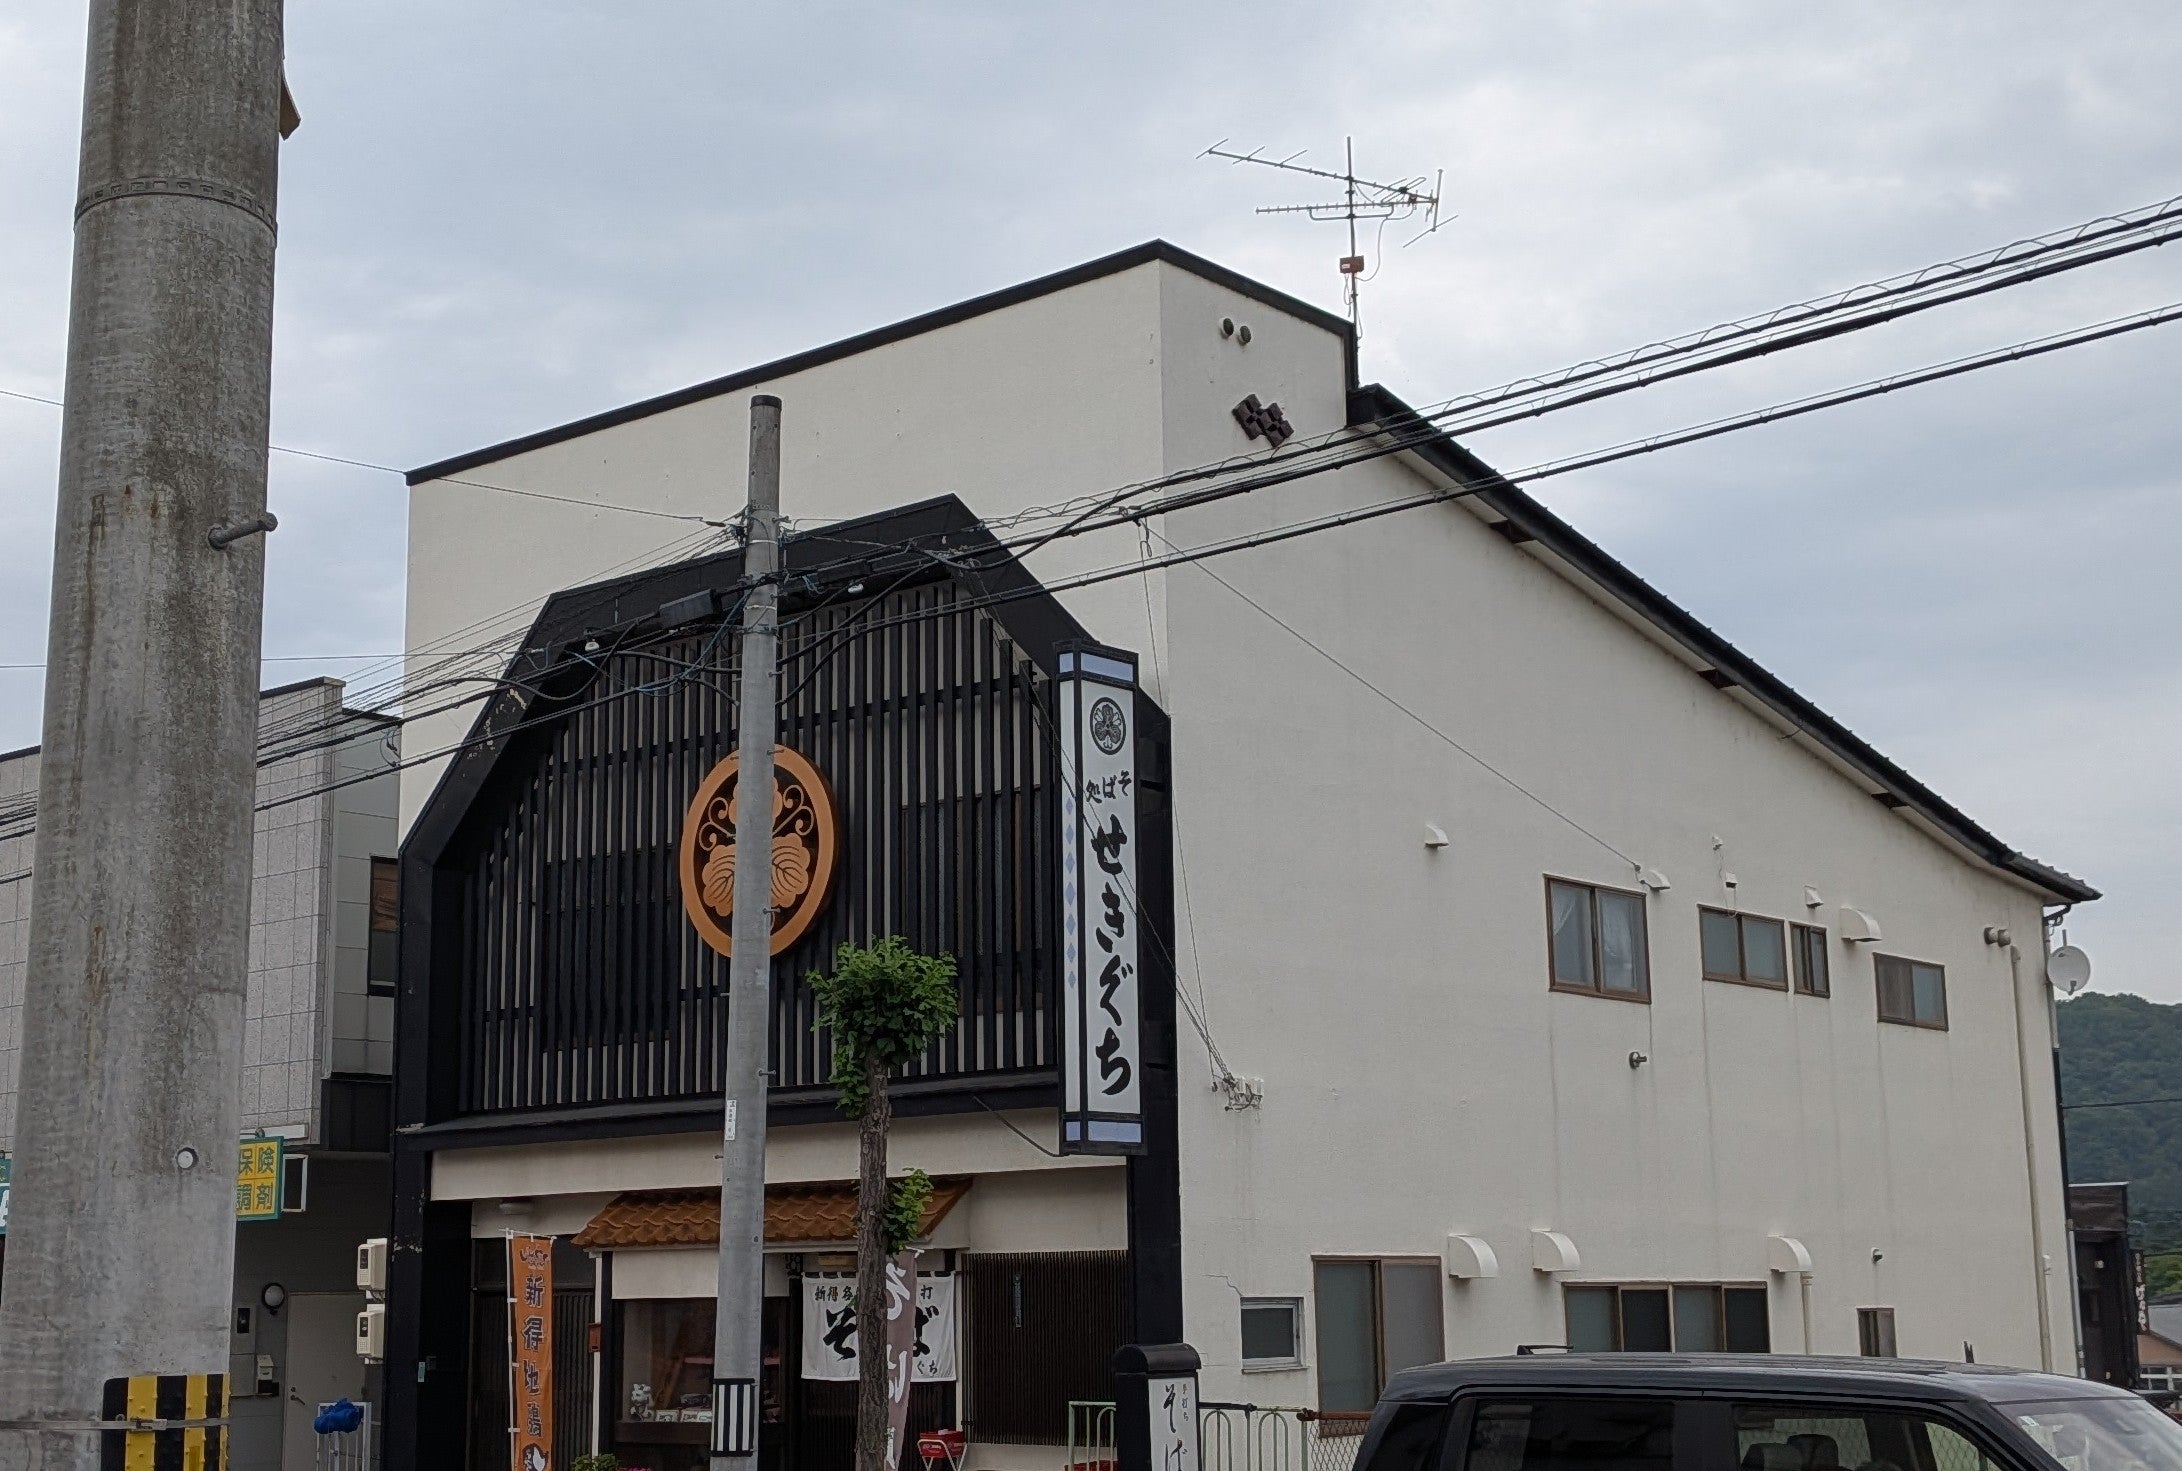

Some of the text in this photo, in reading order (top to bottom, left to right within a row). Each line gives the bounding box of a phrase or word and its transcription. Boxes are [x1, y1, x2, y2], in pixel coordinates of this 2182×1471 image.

[1091, 813, 1133, 1096] せきぐち
[239, 1146, 276, 1175] 保険
